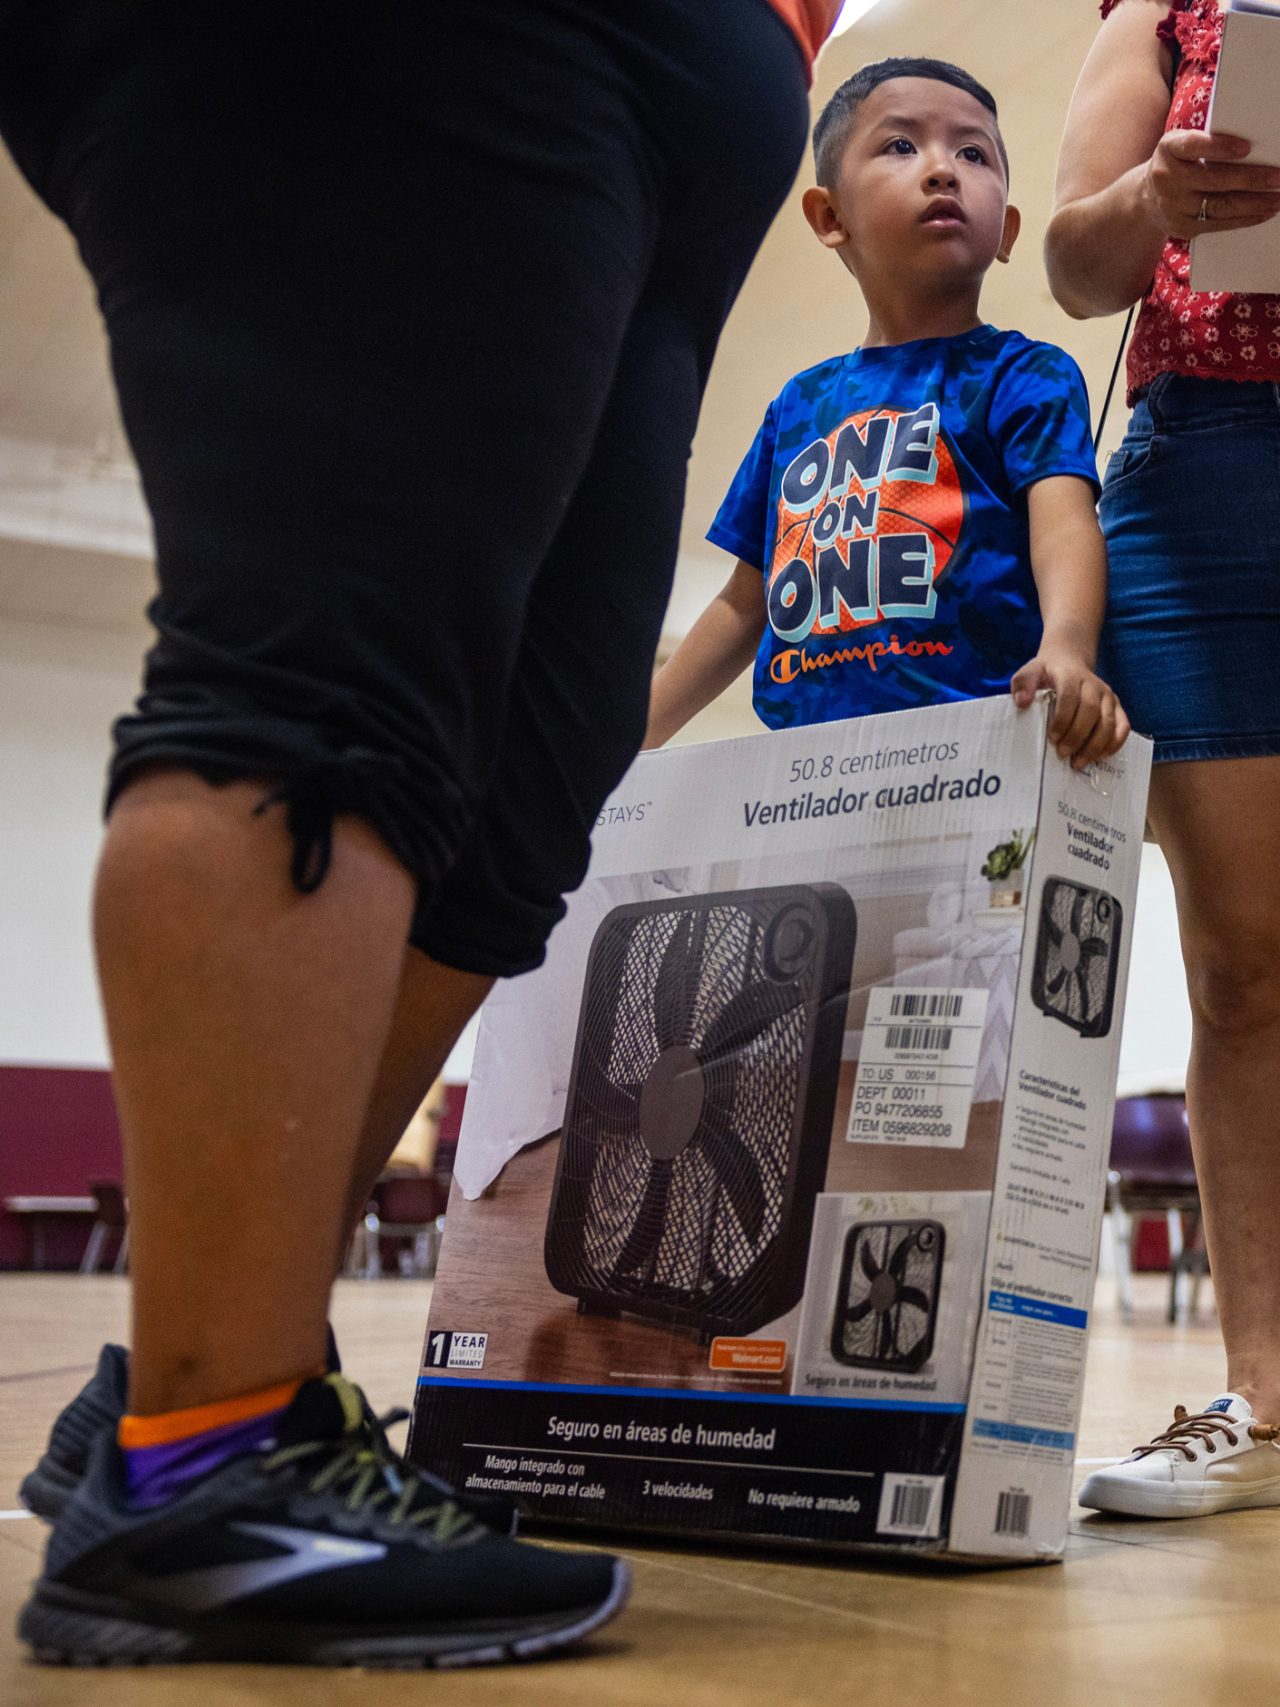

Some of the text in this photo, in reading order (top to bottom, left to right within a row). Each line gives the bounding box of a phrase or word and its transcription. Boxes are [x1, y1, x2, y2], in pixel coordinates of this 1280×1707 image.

[781, 402, 940, 513] ONE
[812, 491, 881, 548] ON
[767, 533, 937, 643] ONE
[770, 634, 954, 684] Champion
[789, 739, 960, 783] 50.8 centímetros
[743, 769, 1001, 827] Ventilador cuadrado
[1067, 822, 1114, 855] Ventilador
[1067, 844, 1110, 870] cuadrado
[878, 1068, 894, 1080] US
[857, 1086, 925, 1100] DEPT 00011
[855, 1101, 872, 1115] PO
[852, 1119, 880, 1133] ITEM
[431, 1333, 486, 1365] 1 YEAR
[450, 1349, 483, 1359] LIMITED
[450, 1359, 481, 1367] WARRANTY
[805, 1373, 837, 1389] Seguro
[547, 1416, 776, 1450] Seguro en áreas de humedad
[485, 1454, 585, 1476] Mango integrado con
[465, 1474, 606, 1499] almacenamiento para el cable
[642, 1480, 714, 1500] 3 velocidades
[748, 1488, 861, 1513] No requiere armado
